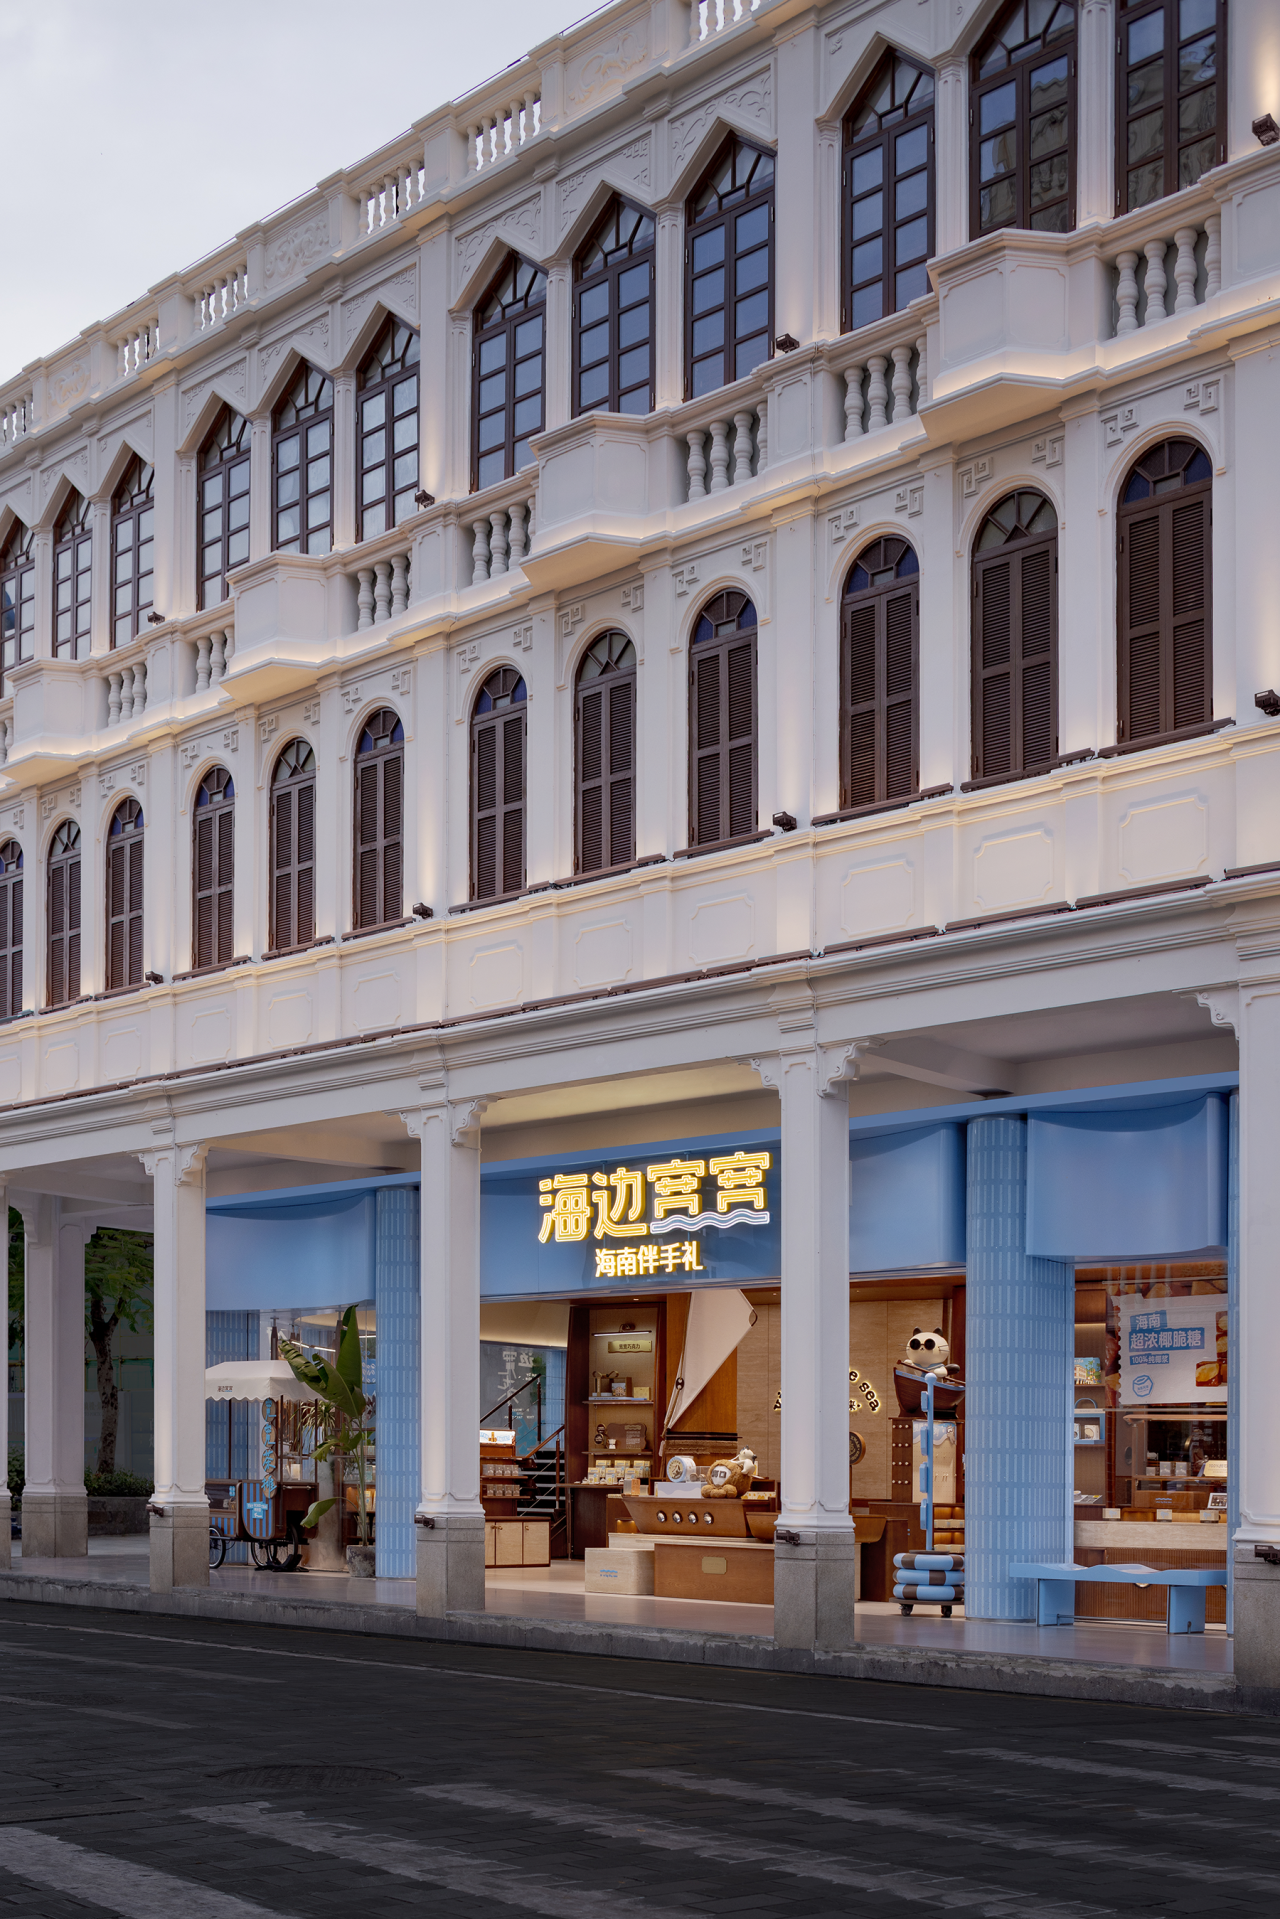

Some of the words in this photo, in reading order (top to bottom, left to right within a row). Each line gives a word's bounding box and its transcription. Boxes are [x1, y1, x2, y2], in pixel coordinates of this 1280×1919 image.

[594, 1241, 705, 1278] 海南伴手礼
[1135, 1313, 1161, 1330] 海南
[1130, 1329, 1202, 1349] 超浓椰脆糖
[858, 1382, 880, 1412] sea
